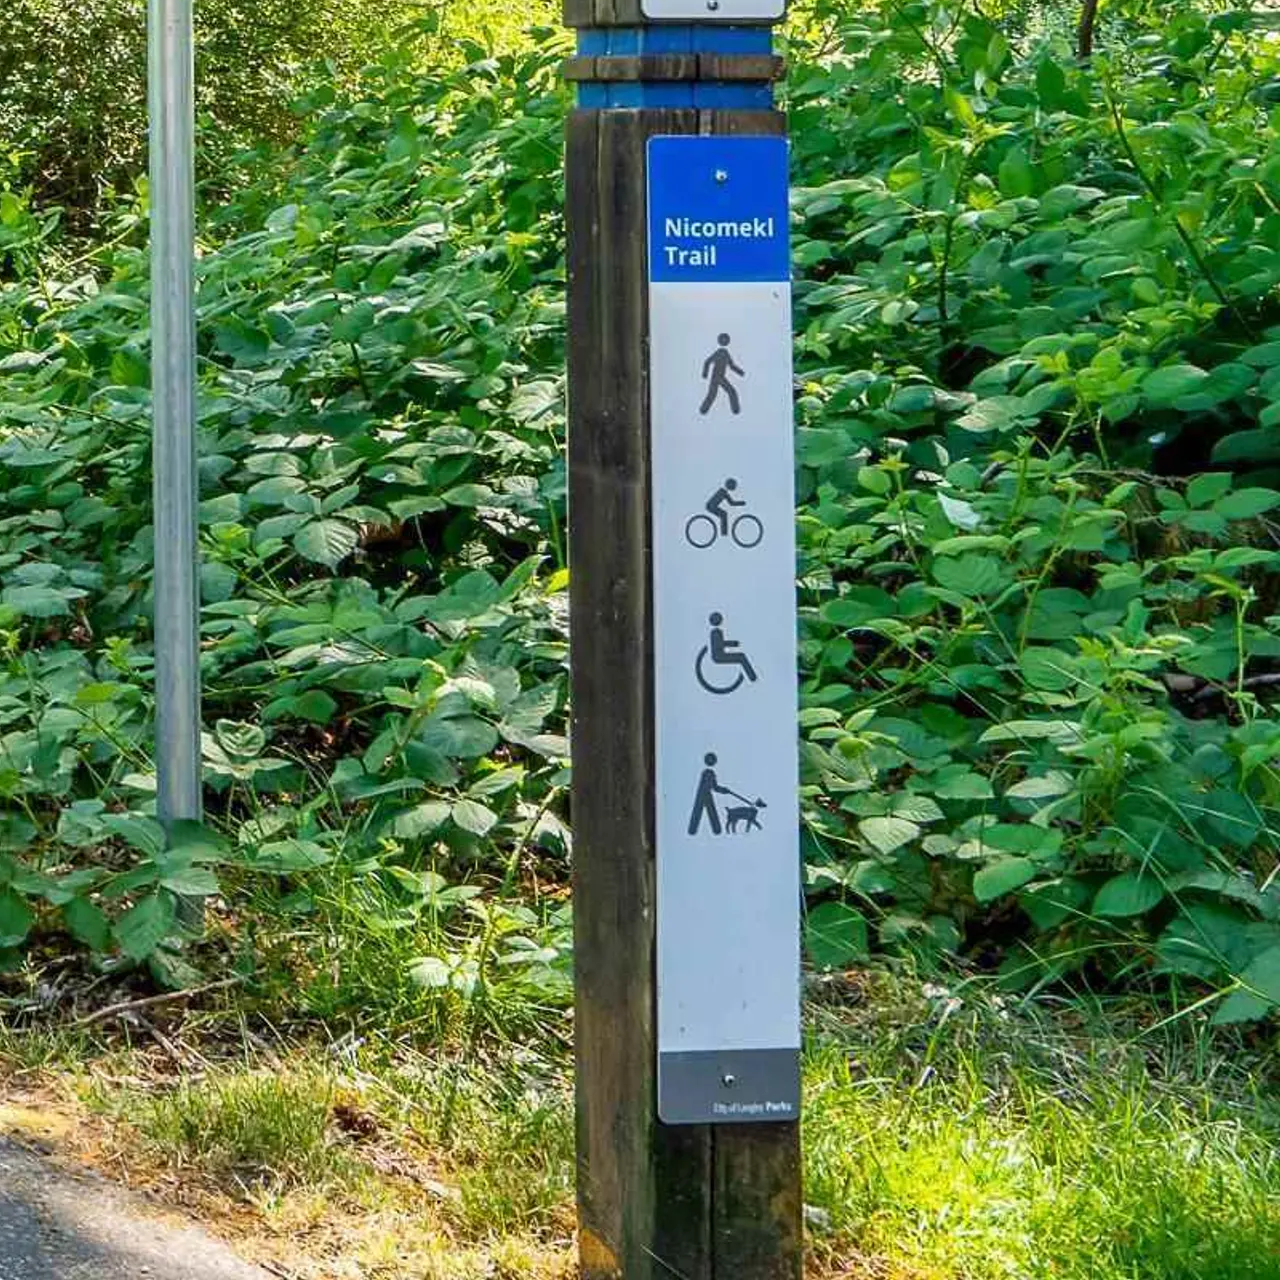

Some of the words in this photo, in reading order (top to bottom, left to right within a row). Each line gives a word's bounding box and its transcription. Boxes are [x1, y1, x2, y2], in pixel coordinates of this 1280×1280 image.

[665, 217, 774, 238] Nicomekl
[663, 245, 716, 267] Trail
[765, 1101, 793, 1112] Parks
